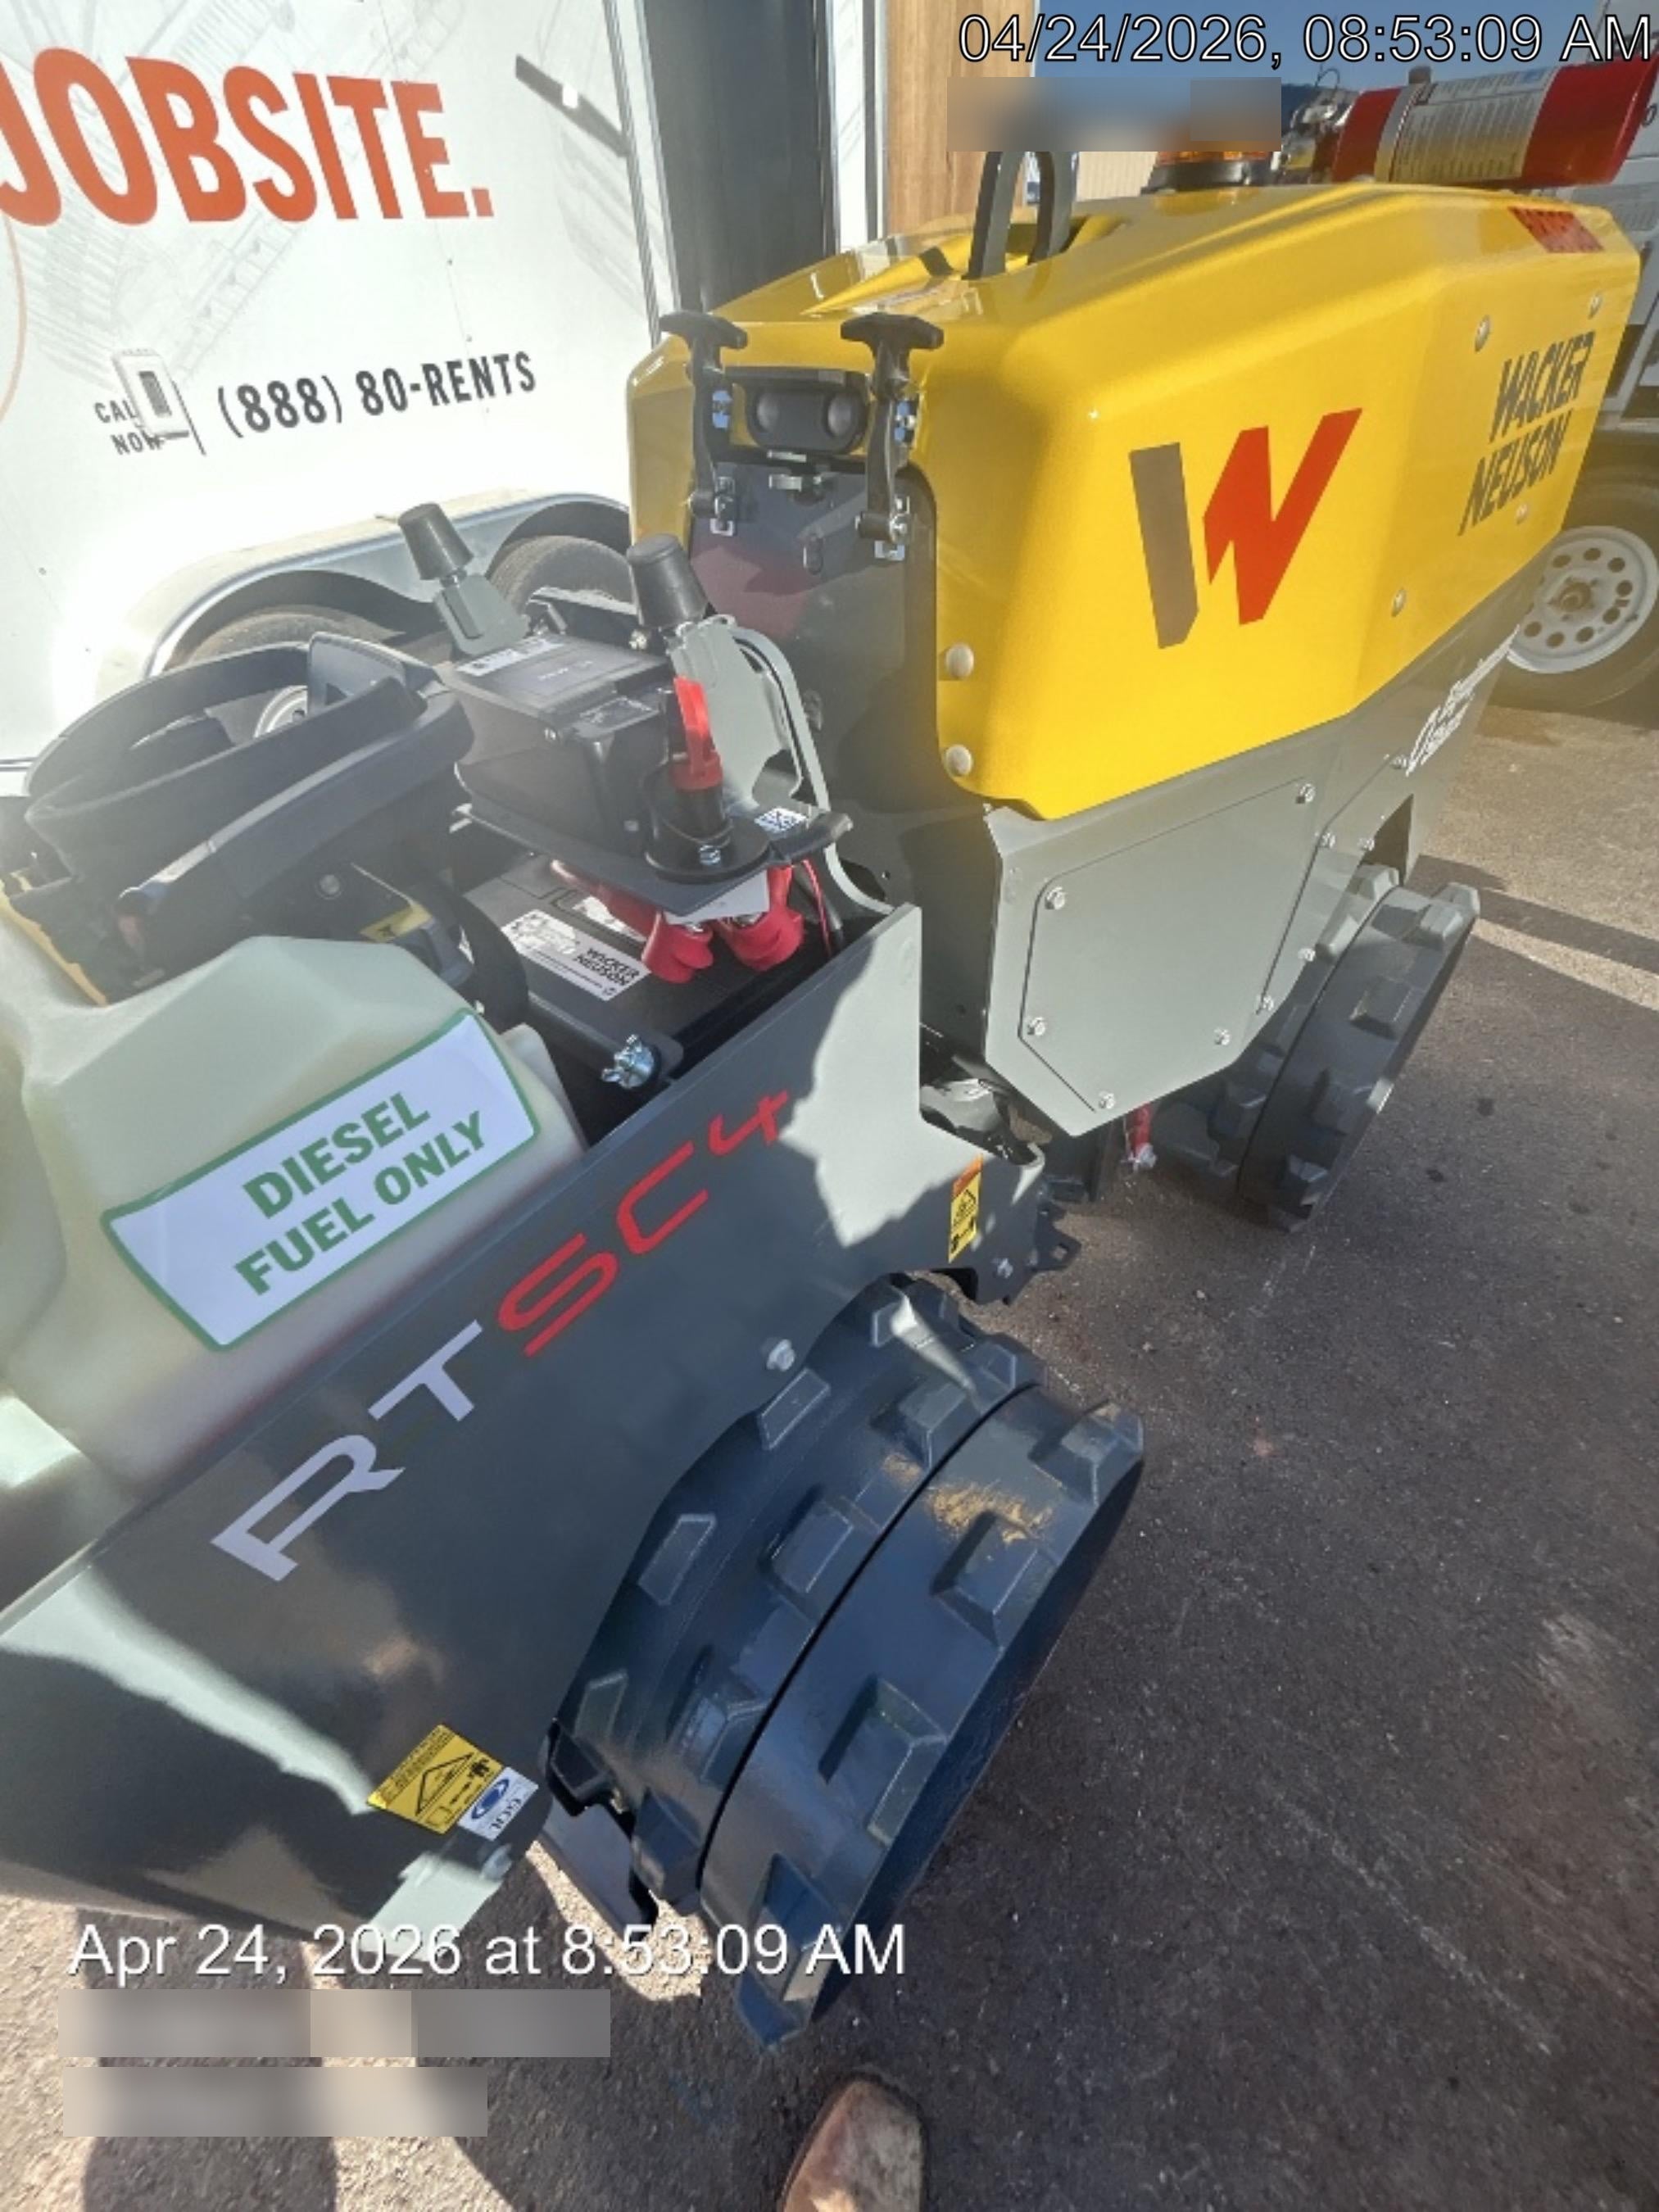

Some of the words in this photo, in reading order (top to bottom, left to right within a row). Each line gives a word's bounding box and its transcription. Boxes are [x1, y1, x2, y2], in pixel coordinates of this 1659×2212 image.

[0, 48, 494, 226] JOBSITE.
[218, 375, 342, 438] (888)
[356, 351, 536, 416] 80-RENTS
[1489, 331, 1596, 443] WACKER
[1457, 408, 1574, 537] NEUSON
[233, 1198, 374, 1296] FUEL
[373, 1110, 487, 1205] ONLY
[242, 1092, 430, 1219] DIESEL
